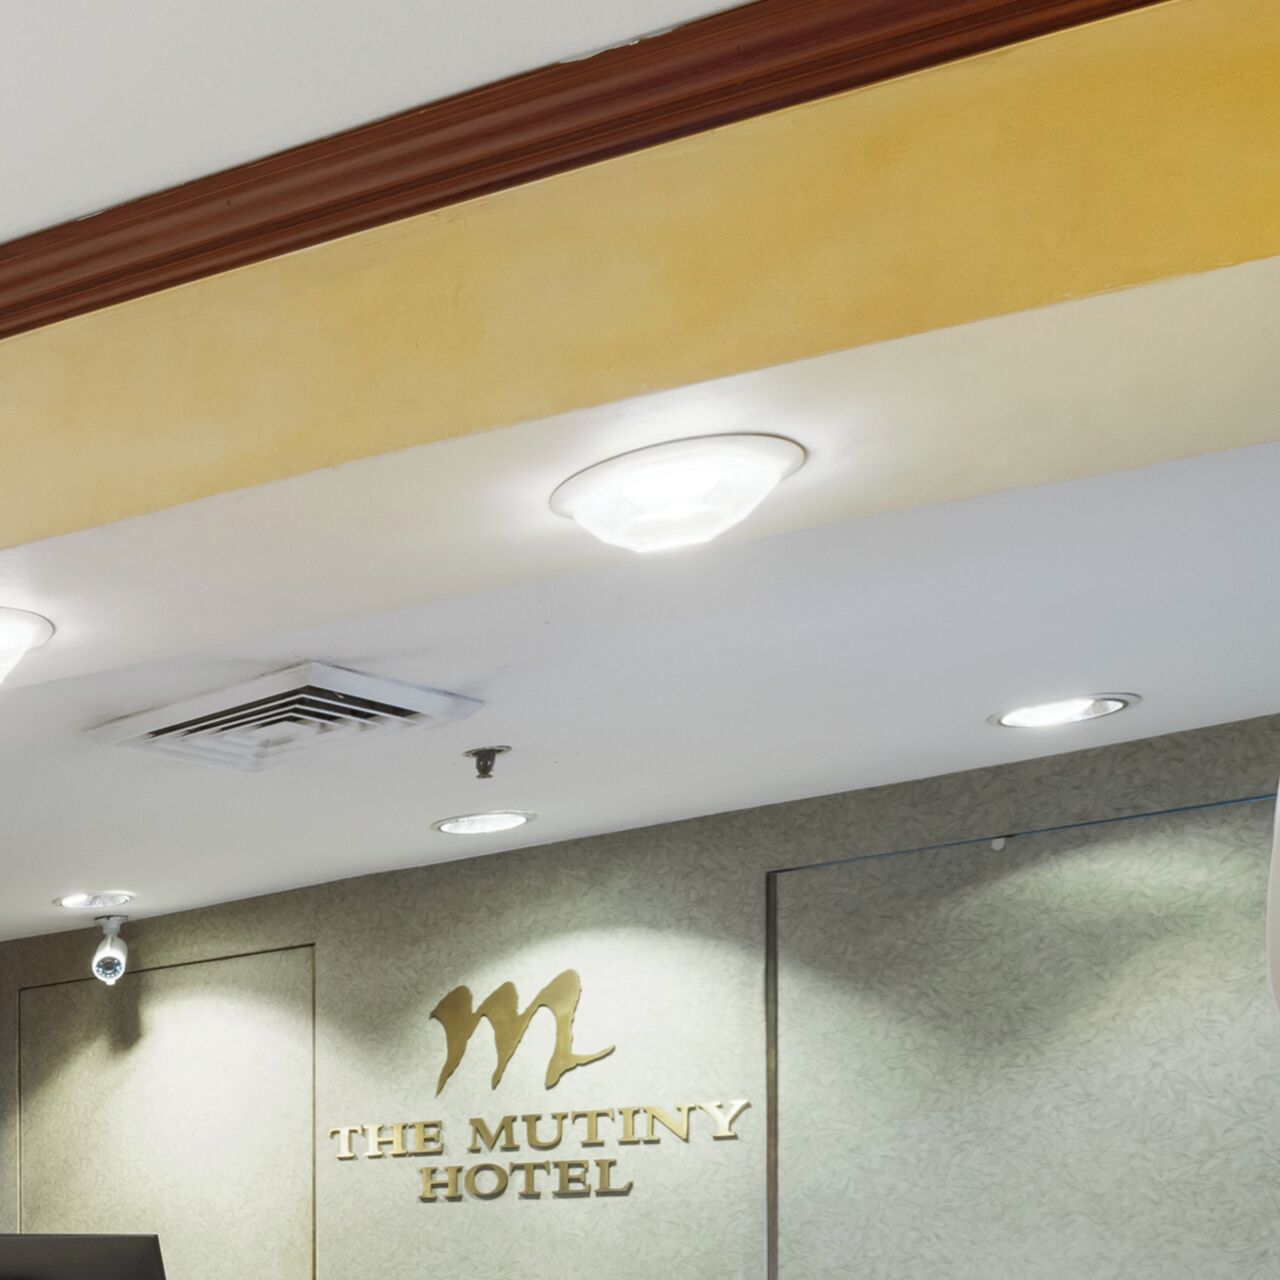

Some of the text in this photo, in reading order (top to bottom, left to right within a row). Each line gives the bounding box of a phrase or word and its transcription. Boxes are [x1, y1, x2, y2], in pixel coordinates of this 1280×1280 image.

[329, 1099, 752, 1160] THE MUTINY
[418, 1158, 634, 1203] HOTEL
